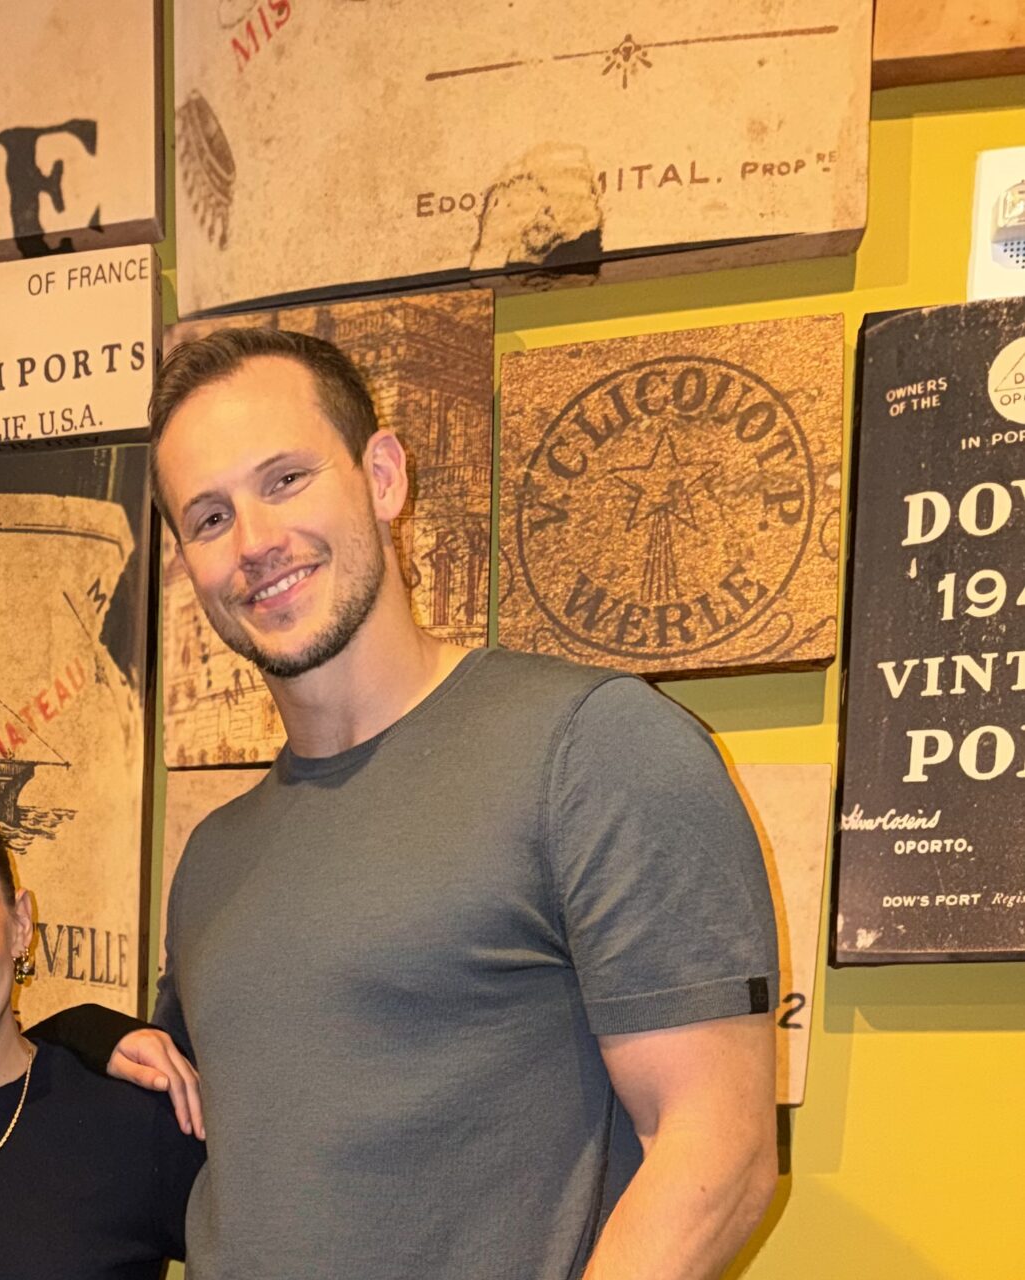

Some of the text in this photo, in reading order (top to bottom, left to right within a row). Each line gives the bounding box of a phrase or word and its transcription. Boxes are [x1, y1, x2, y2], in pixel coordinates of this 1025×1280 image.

[28, 257, 149, 296] OF FRANCE
[885, 377, 948, 402] OWNERS
[999, 393, 1025, 406] OP
[889, 394, 941, 417] OF THE
[960, 436, 981, 450] IN
[564, 564, 771, 648] WERLE
[937, 569, 1025, 620] 19
[902, 725, 1025, 782] PO
[894, 838, 973, 855] OPORTO.
[882, 894, 930, 908] DOW'S
[935, 893, 982, 907] PORT
